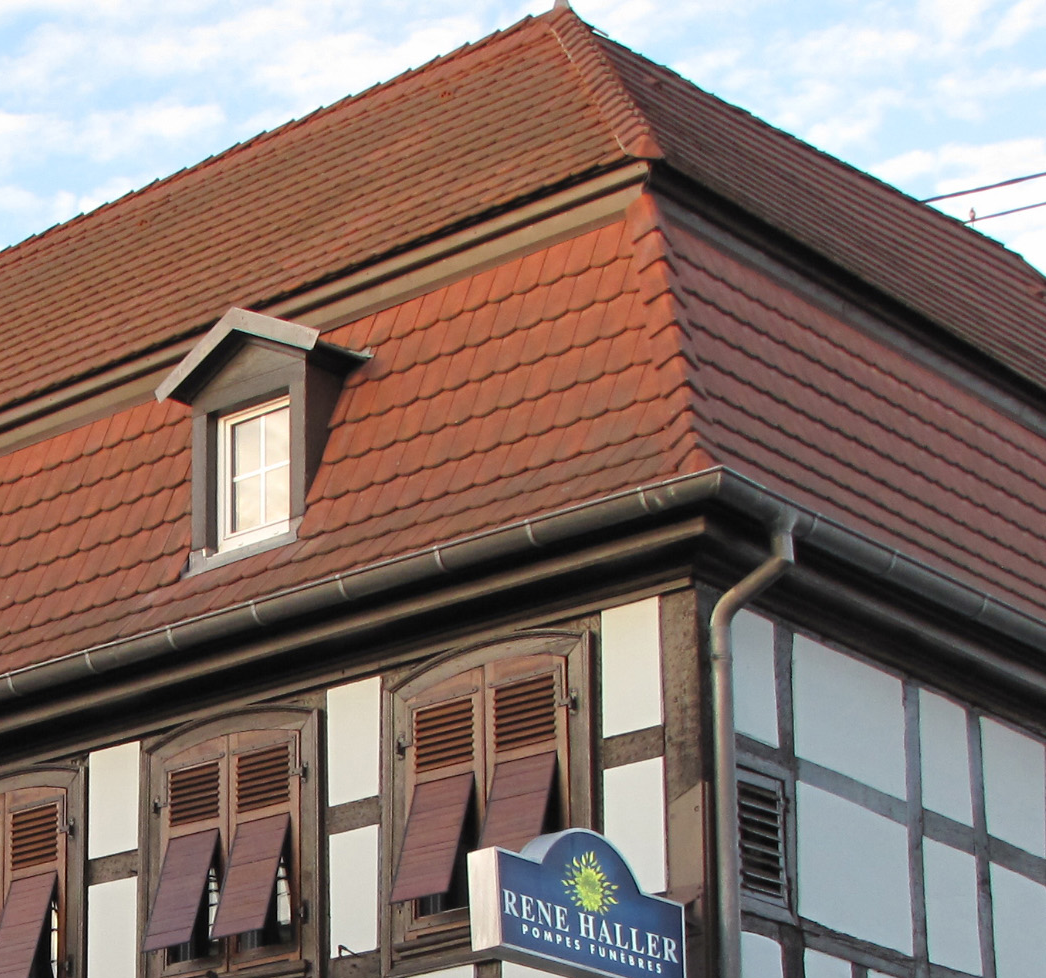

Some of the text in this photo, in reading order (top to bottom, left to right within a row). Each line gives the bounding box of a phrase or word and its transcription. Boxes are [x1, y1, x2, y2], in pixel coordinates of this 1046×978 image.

[503, 889, 679, 964] RENE HALLER
[521, 924, 662, 974] POMPES FUNÈBRES
